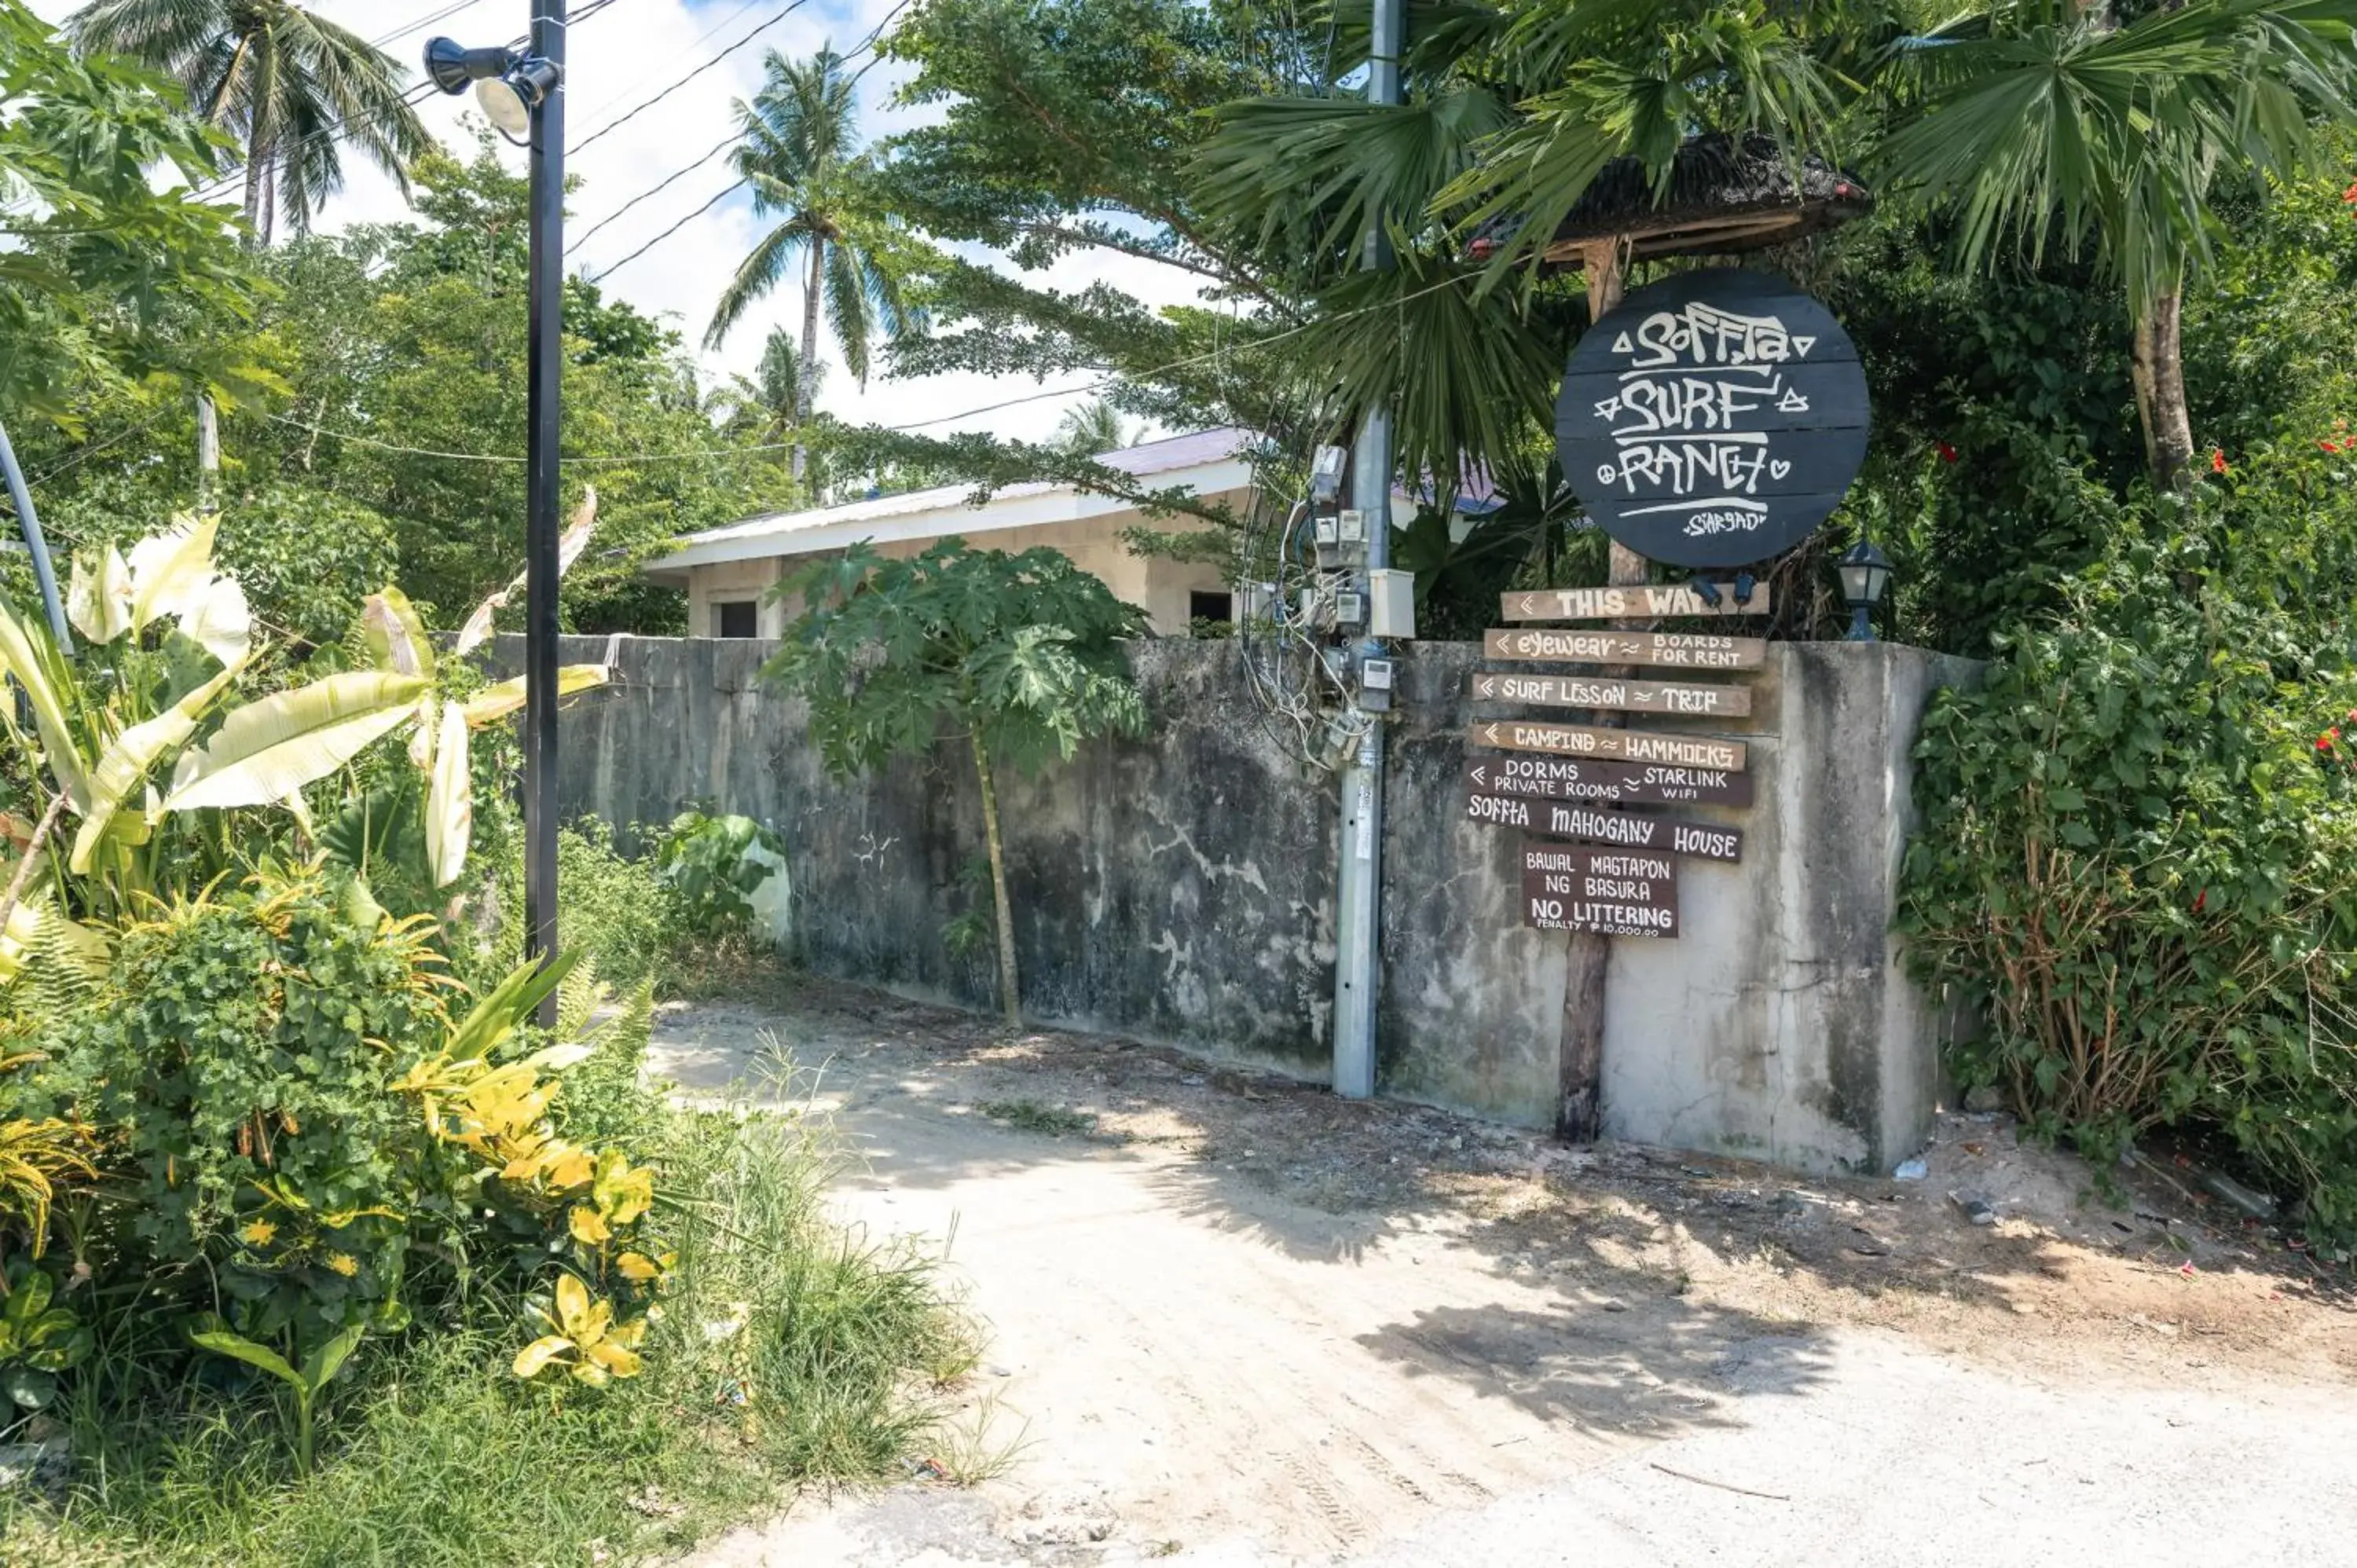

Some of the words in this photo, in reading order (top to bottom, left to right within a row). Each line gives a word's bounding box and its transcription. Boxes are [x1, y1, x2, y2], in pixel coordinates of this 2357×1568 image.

[1611, 373, 1781, 436] SURF
[1556, 589, 1626, 617] THIS
[1654, 635, 1732, 649] BOARDS
[1652, 649, 1689, 664] FOR
[1695, 651, 1741, 666] RENT
[1501, 679, 1554, 701] SURF
[1661, 687, 1718, 712] TRIP
[1514, 727, 1596, 751] CAMPING
[1625, 737, 1734, 767] HAMMOCKS
[1505, 760, 1578, 779] DORMS
[1644, 768, 1728, 788] STARLINK
[1494, 776, 1556, 795] PRIVATE
[1566, 783, 1620, 798] ROOMS
[1673, 827, 1738, 857] HOUSE
[1527, 852, 1576, 872] BAWAL
[1590, 855, 1671, 880] MAGTAPON
[1545, 874, 1571, 894] NG
[1585, 877, 1651, 901] BASURA
[1531, 898, 1563, 920] NO
[1574, 901, 1673, 928] LITTERING
[1537, 918, 1582, 931] PENALTY
